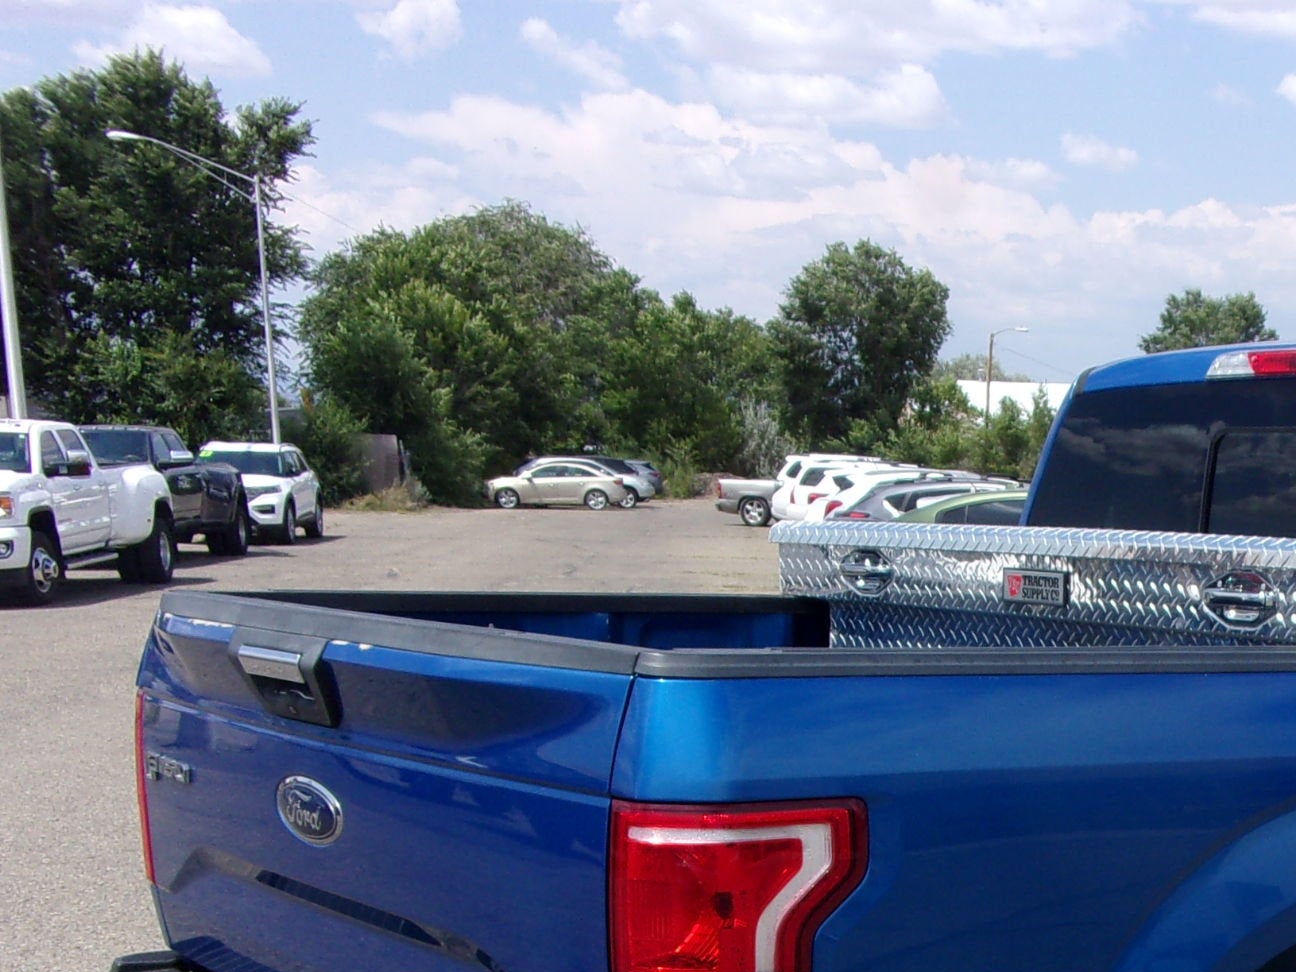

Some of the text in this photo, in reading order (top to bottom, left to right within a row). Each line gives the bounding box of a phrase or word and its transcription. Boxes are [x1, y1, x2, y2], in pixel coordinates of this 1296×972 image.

[1022, 575, 1060, 588] TRACTOR
[1022, 587, 1049, 600] SUPPLY
[286, 789, 322, 831] Ford
